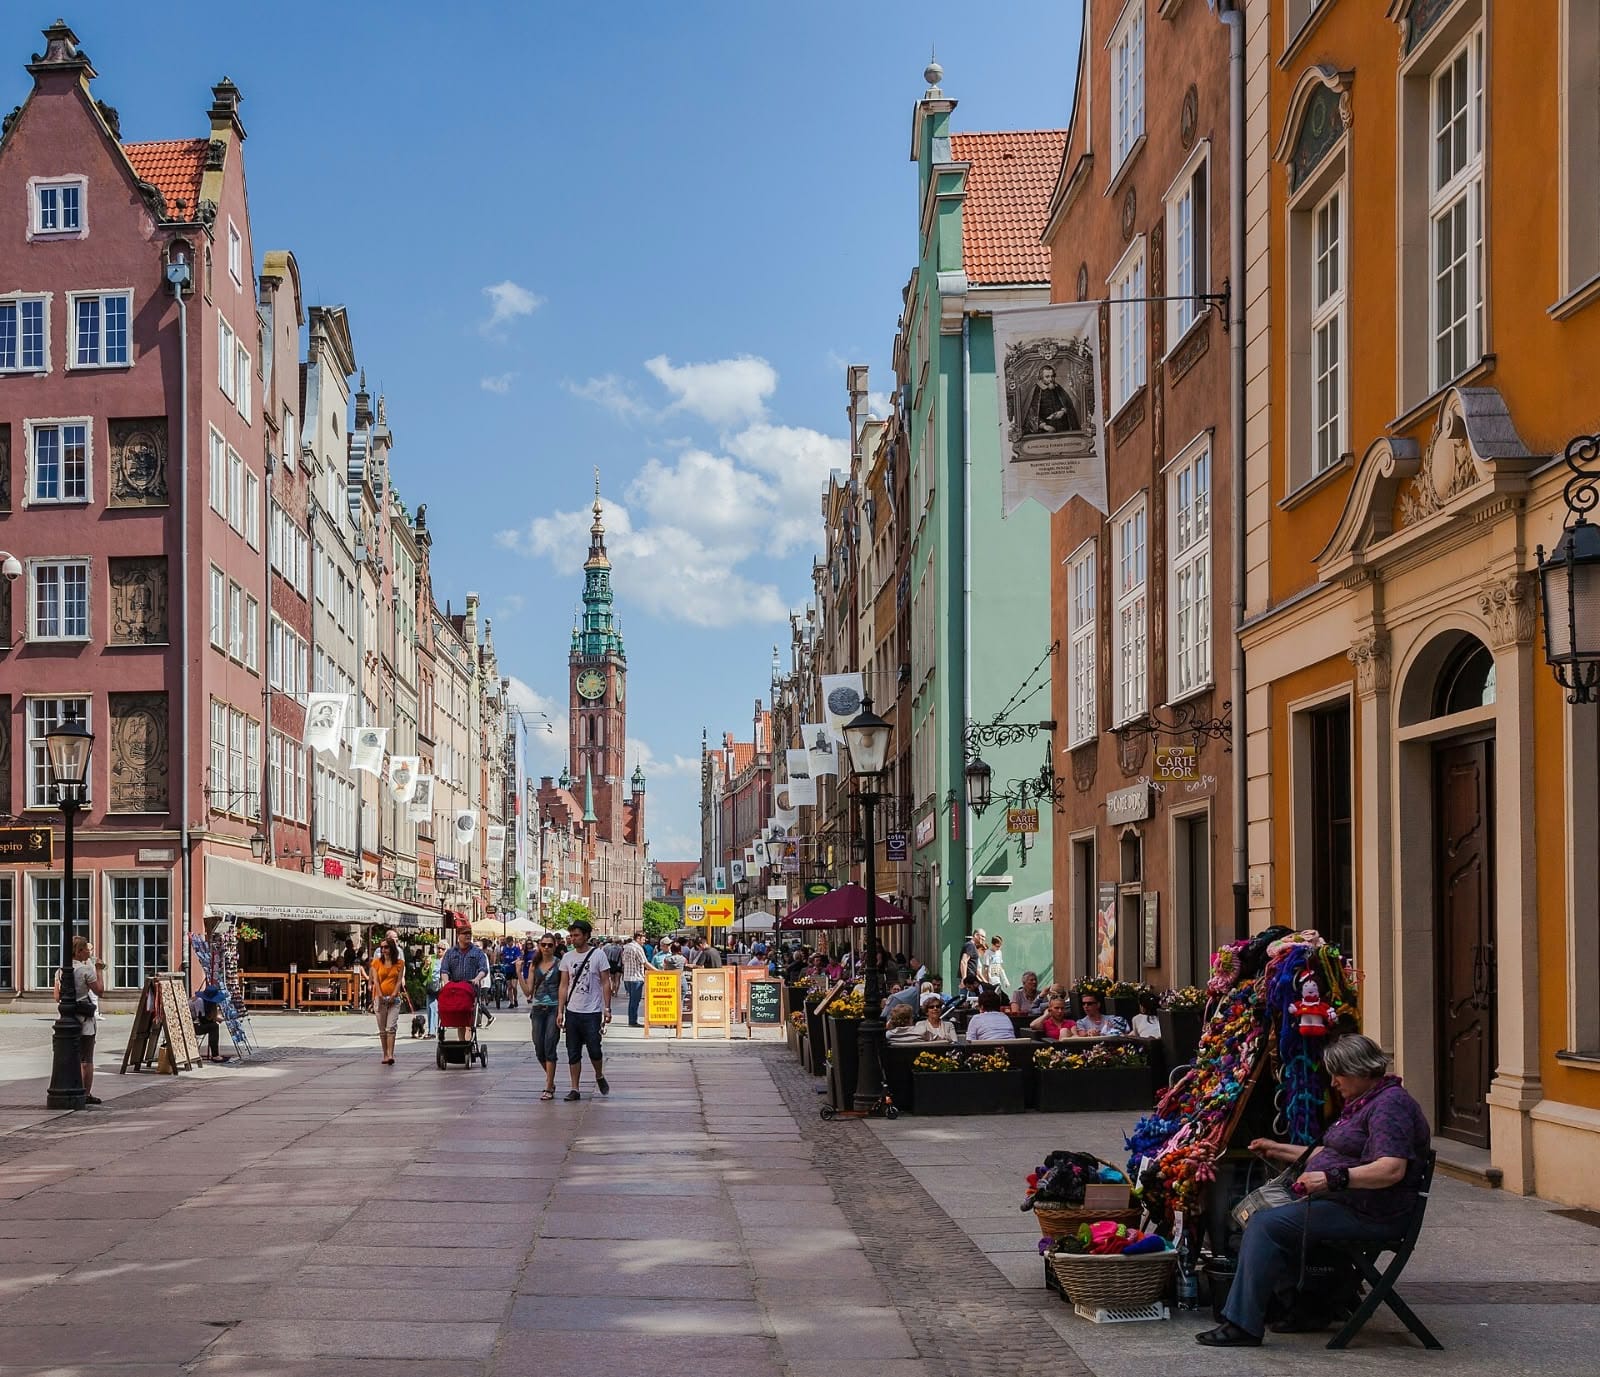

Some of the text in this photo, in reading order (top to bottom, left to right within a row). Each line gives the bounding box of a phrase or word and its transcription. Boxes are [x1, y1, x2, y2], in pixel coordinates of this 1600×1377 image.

[1156, 755, 1197, 767] CARTE
[1161, 767, 1193, 779] D'OR
[1009, 815, 1037, 823] CARTE
[1012, 823, 1034, 831] D'OR
